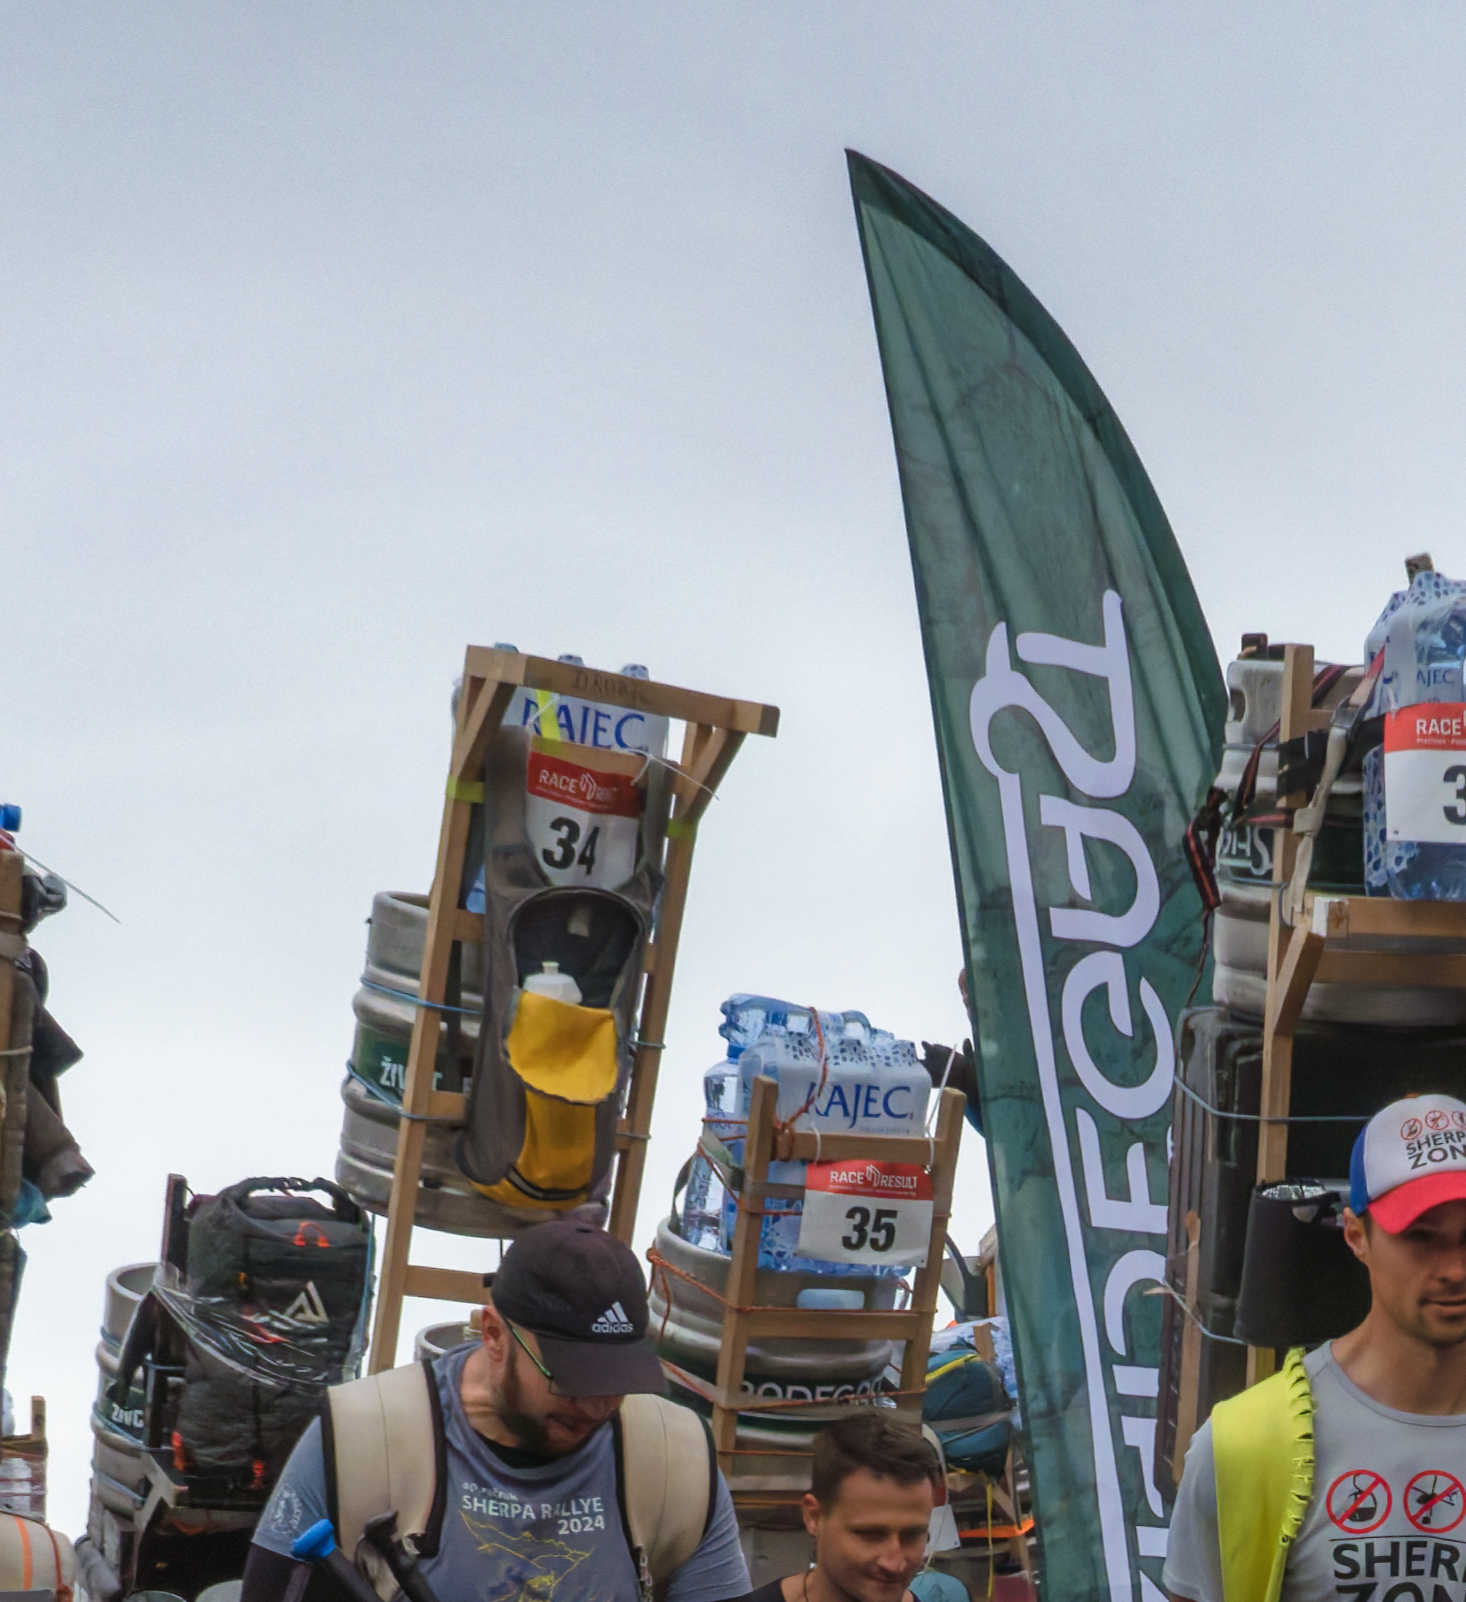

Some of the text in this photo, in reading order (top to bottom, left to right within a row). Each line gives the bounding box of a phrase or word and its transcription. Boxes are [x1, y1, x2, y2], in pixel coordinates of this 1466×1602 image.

[1417, 718, 1462, 735] RACE
[539, 769, 577, 793] RACE
[542, 817, 600, 876] 34
[829, 1170, 918, 1190] RACE RESULT
[842, 1206, 898, 1252] 35
[591, 1320, 634, 1333] adidas
[462, 1494, 604, 1521] SHERPA RALLYE
[558, 1515, 606, 1535] 2024
